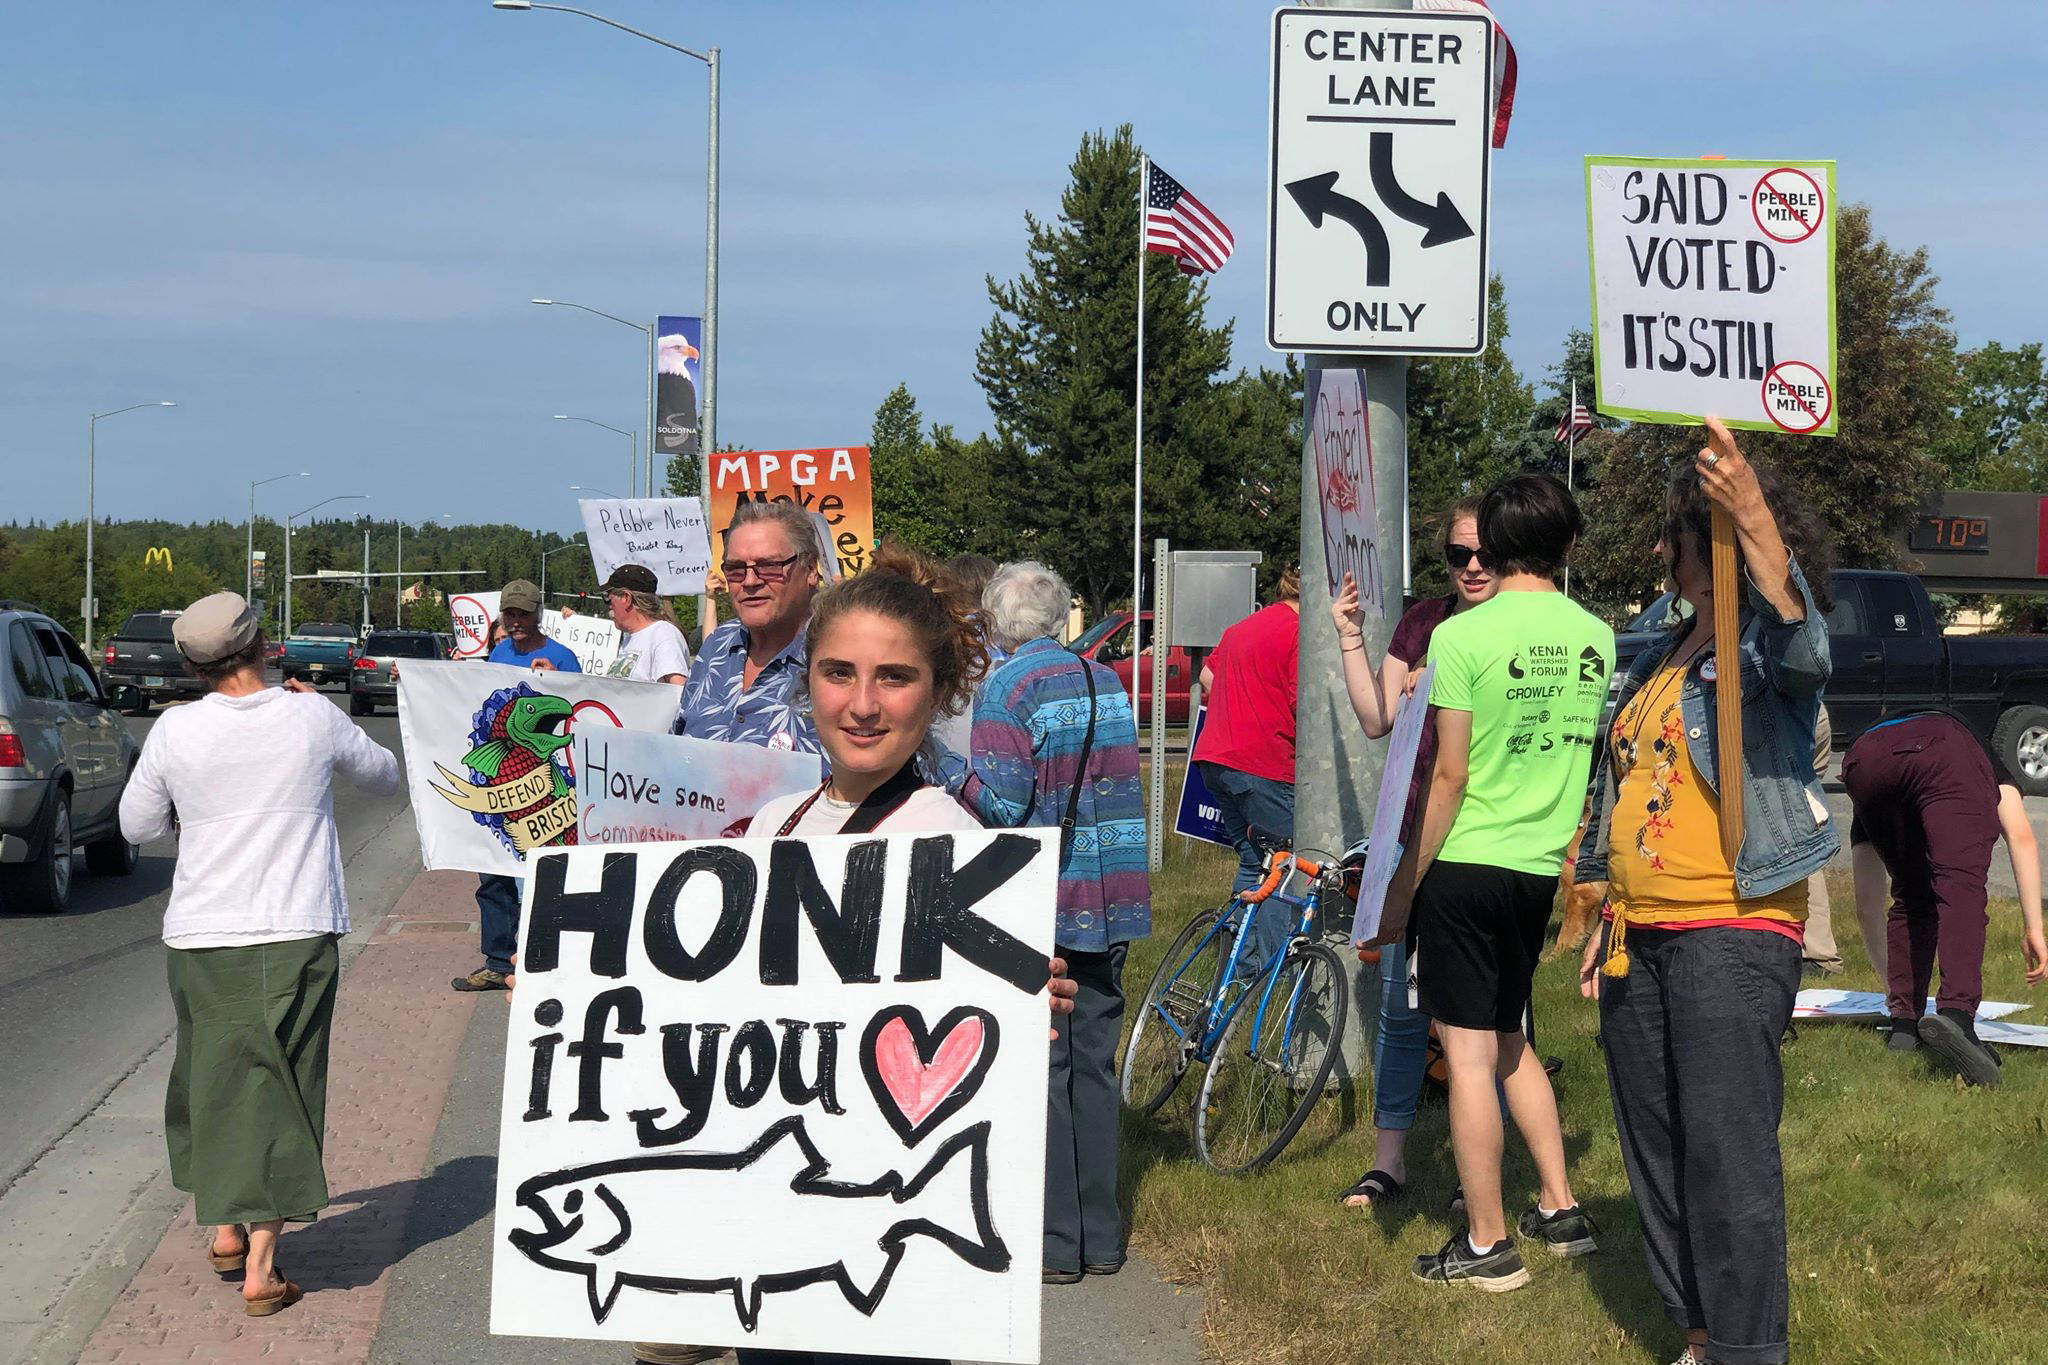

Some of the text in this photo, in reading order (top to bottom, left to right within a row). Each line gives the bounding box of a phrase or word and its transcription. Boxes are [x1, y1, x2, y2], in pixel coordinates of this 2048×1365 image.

[1304, 29, 1462, 64] CENTER
[1328, 75, 1436, 107] LANE
[1759, 192, 1817, 206] PEBBLE
[1767, 208, 1808, 222] MINE
[1327, 300, 1427, 332] ONLY
[1768, 382, 1825, 398] PEBBLE
[1776, 398, 1817, 413] MINE
[657, 426, 697, 435] SOLDOTNA
[716, 450, 856, 490] MPGA
[600, 506, 701, 534] Pebble Never
[569, 627, 580, 642] is
[585, 624, 613, 647] not
[1529, 645, 1568, 656] KENAI
[1531, 667, 1568, 677] FORUM
[1506, 686, 1564, 700] CROWLEY
[585, 738, 726, 813] Have some
[487, 775, 546, 810] DEFEND
[526, 797, 578, 841] BRISTO
[1198, 803, 1225, 824] VOT
[524, 833, 1053, 996] HONK
[523, 986, 846, 1147] if you
